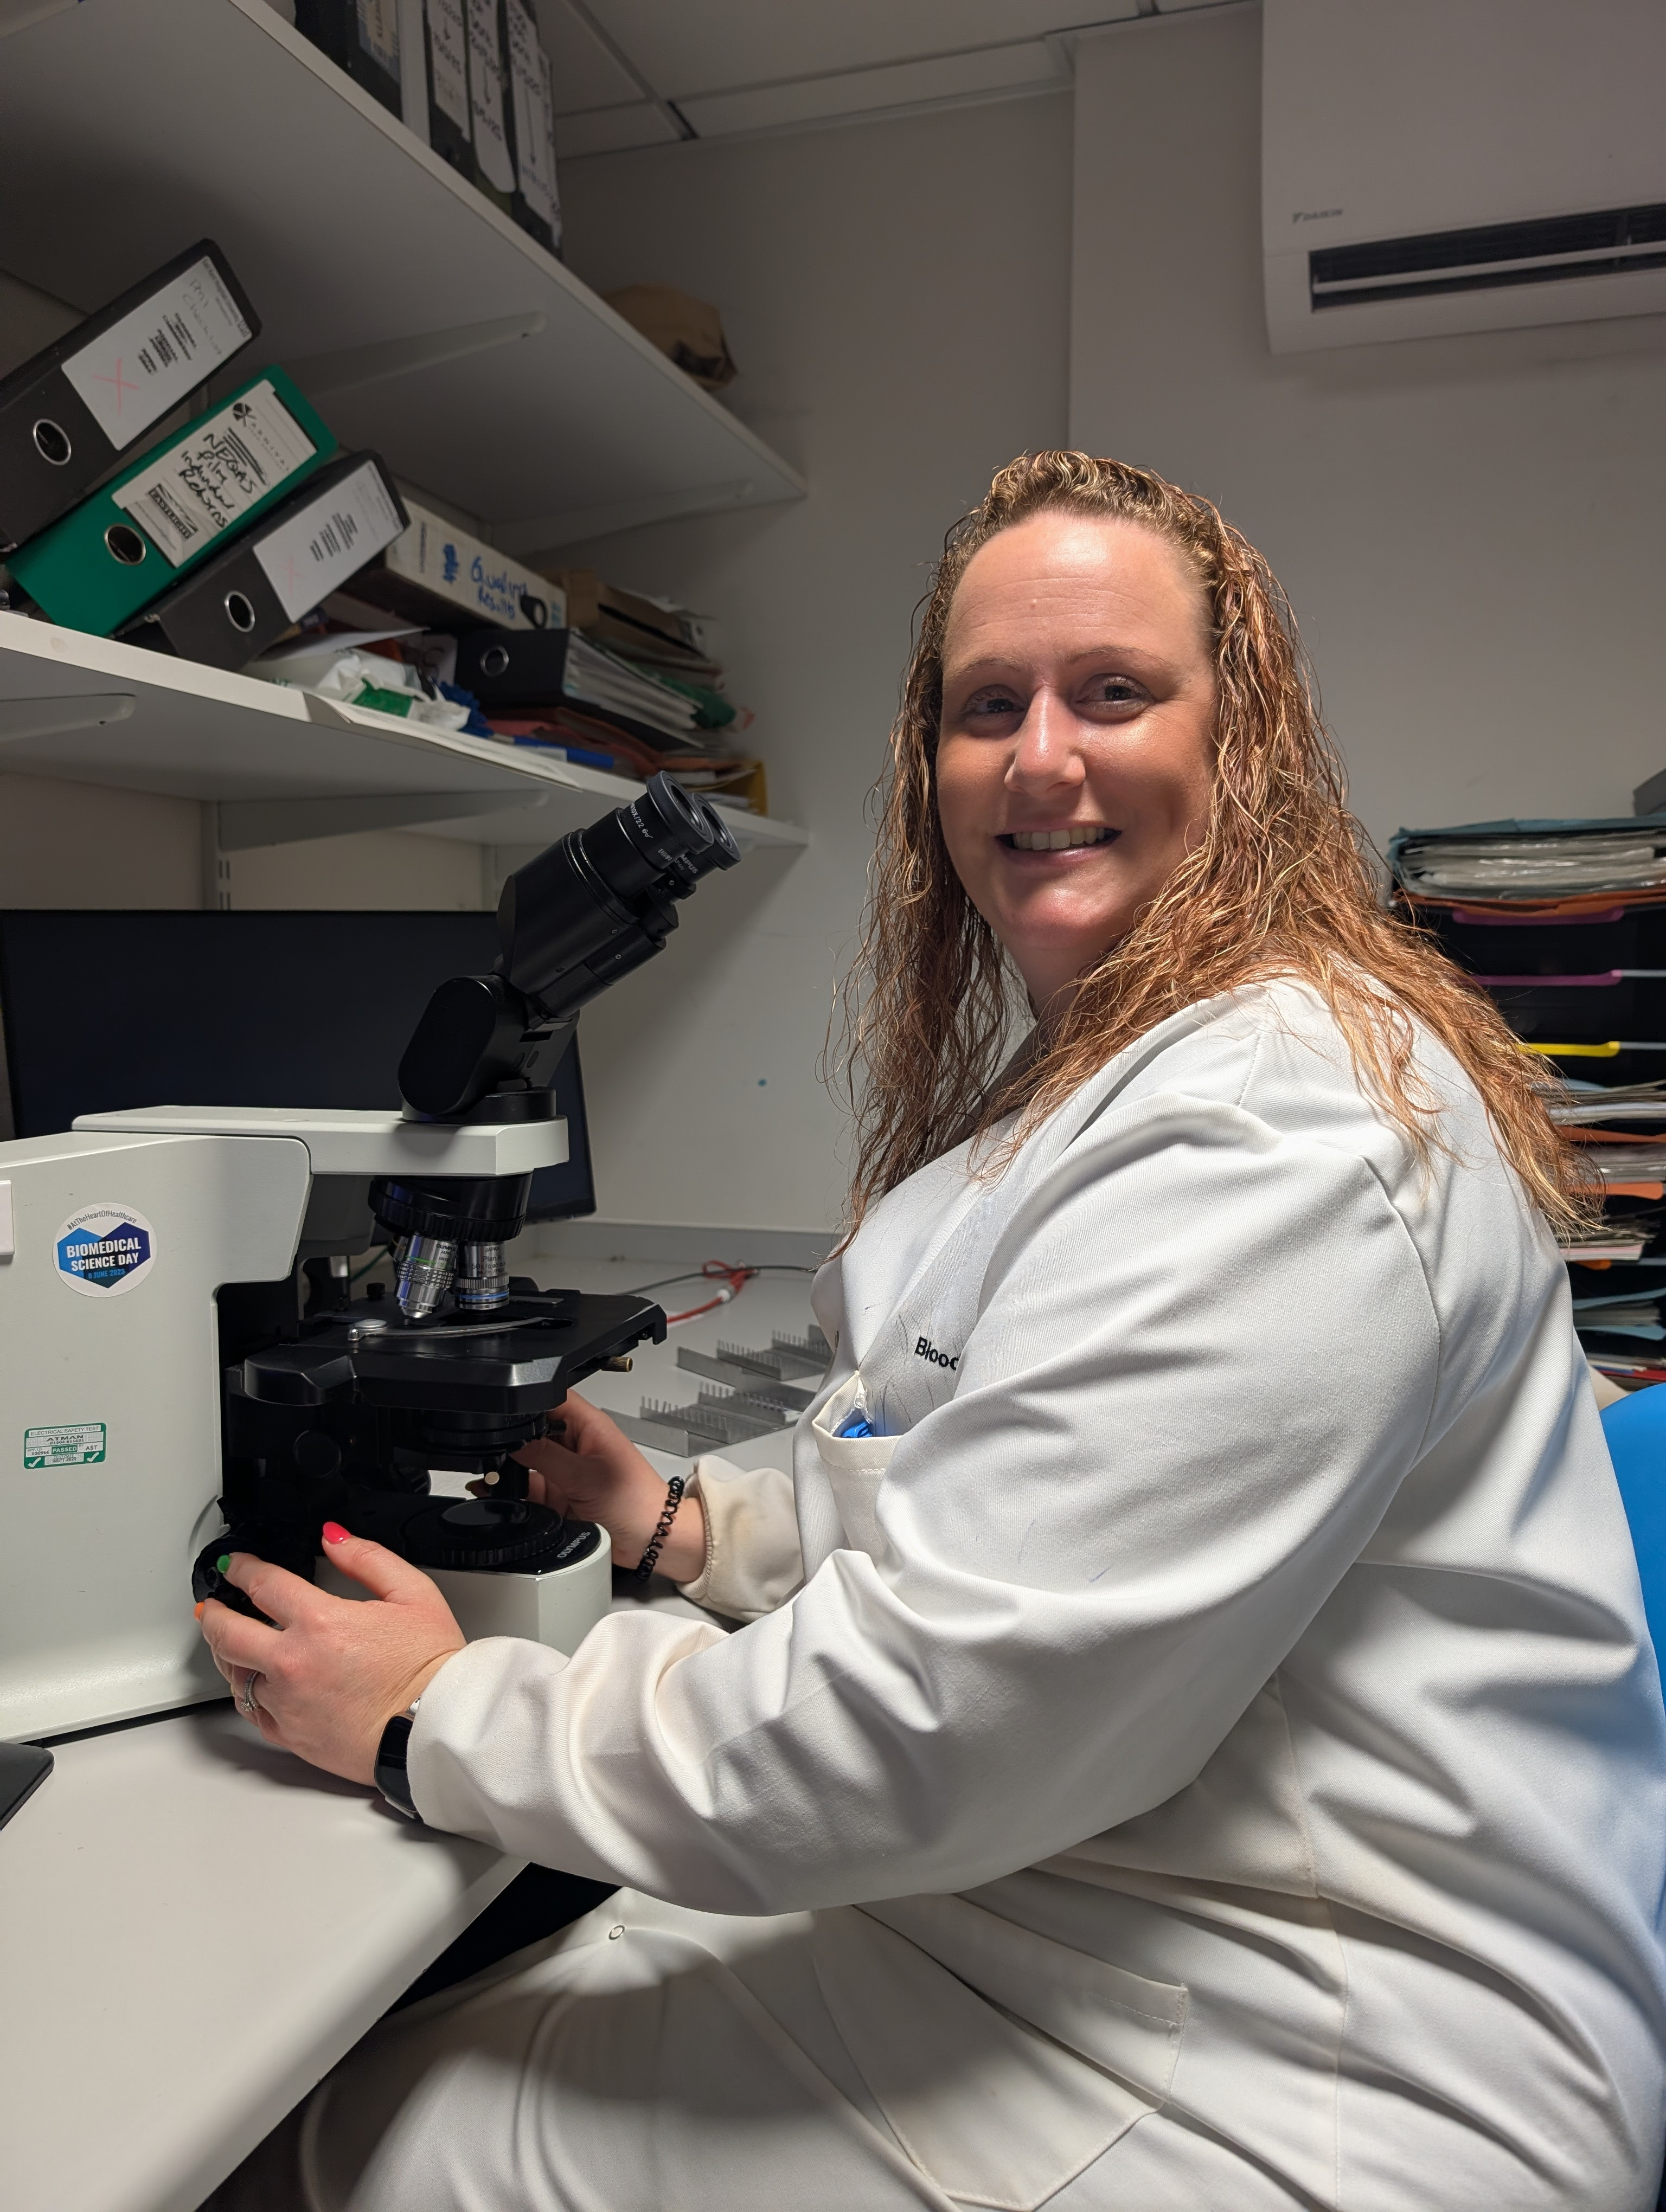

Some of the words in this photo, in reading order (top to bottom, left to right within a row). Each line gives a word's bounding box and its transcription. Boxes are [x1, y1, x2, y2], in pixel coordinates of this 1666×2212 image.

[203, 434, 257, 494] NEQAS
[680, 854, 699, 873] MPUS
[67, 1210, 137, 1230] #AtTheHeartOfHealthcare
[66, 1237, 142, 1258] BIOMEDICAL
[71, 1256, 116, 1271] SCIENCE
[118, 1252, 139, 1265] DAY
[556, 1532, 591, 1558] OLYMPUS
